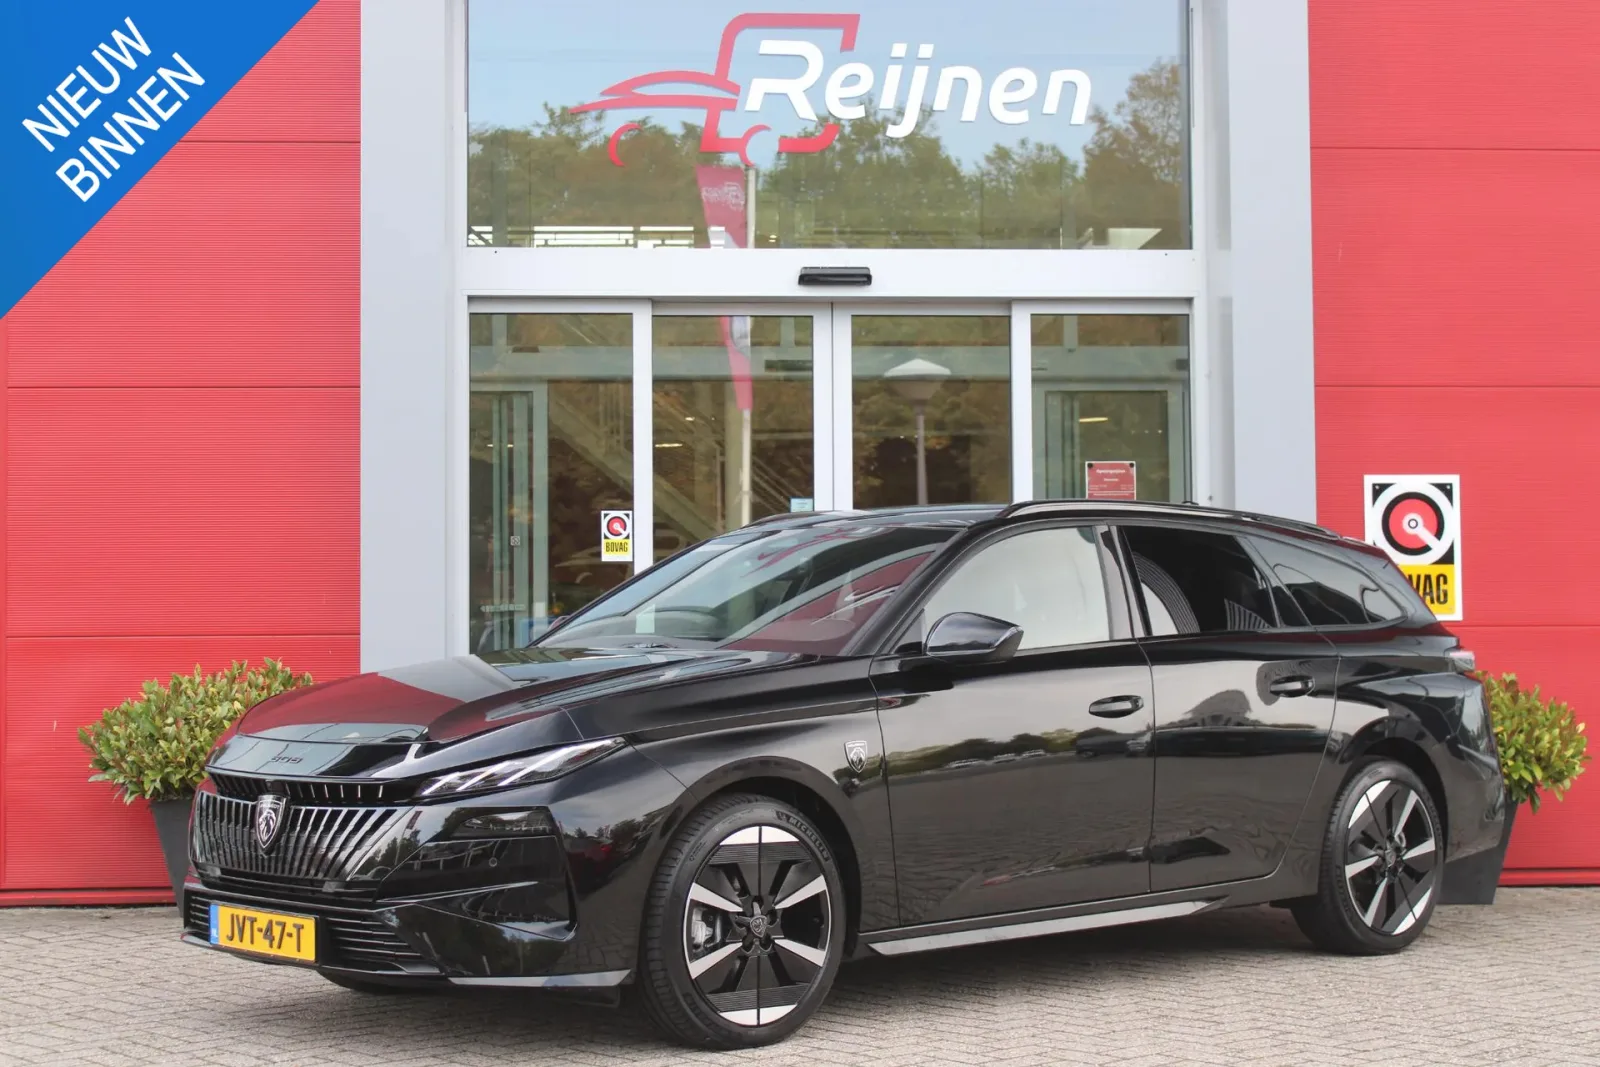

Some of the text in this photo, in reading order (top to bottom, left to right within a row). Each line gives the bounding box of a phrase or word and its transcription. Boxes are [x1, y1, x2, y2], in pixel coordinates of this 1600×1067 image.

[744, 39, 1092, 138] Reijnen
[605, 541, 629, 553] BOVAG
[1408, 573, 1448, 605] VAG
[788, 815, 830, 860] MICHELIN
[226, 913, 305, 953] JVT-47-T
